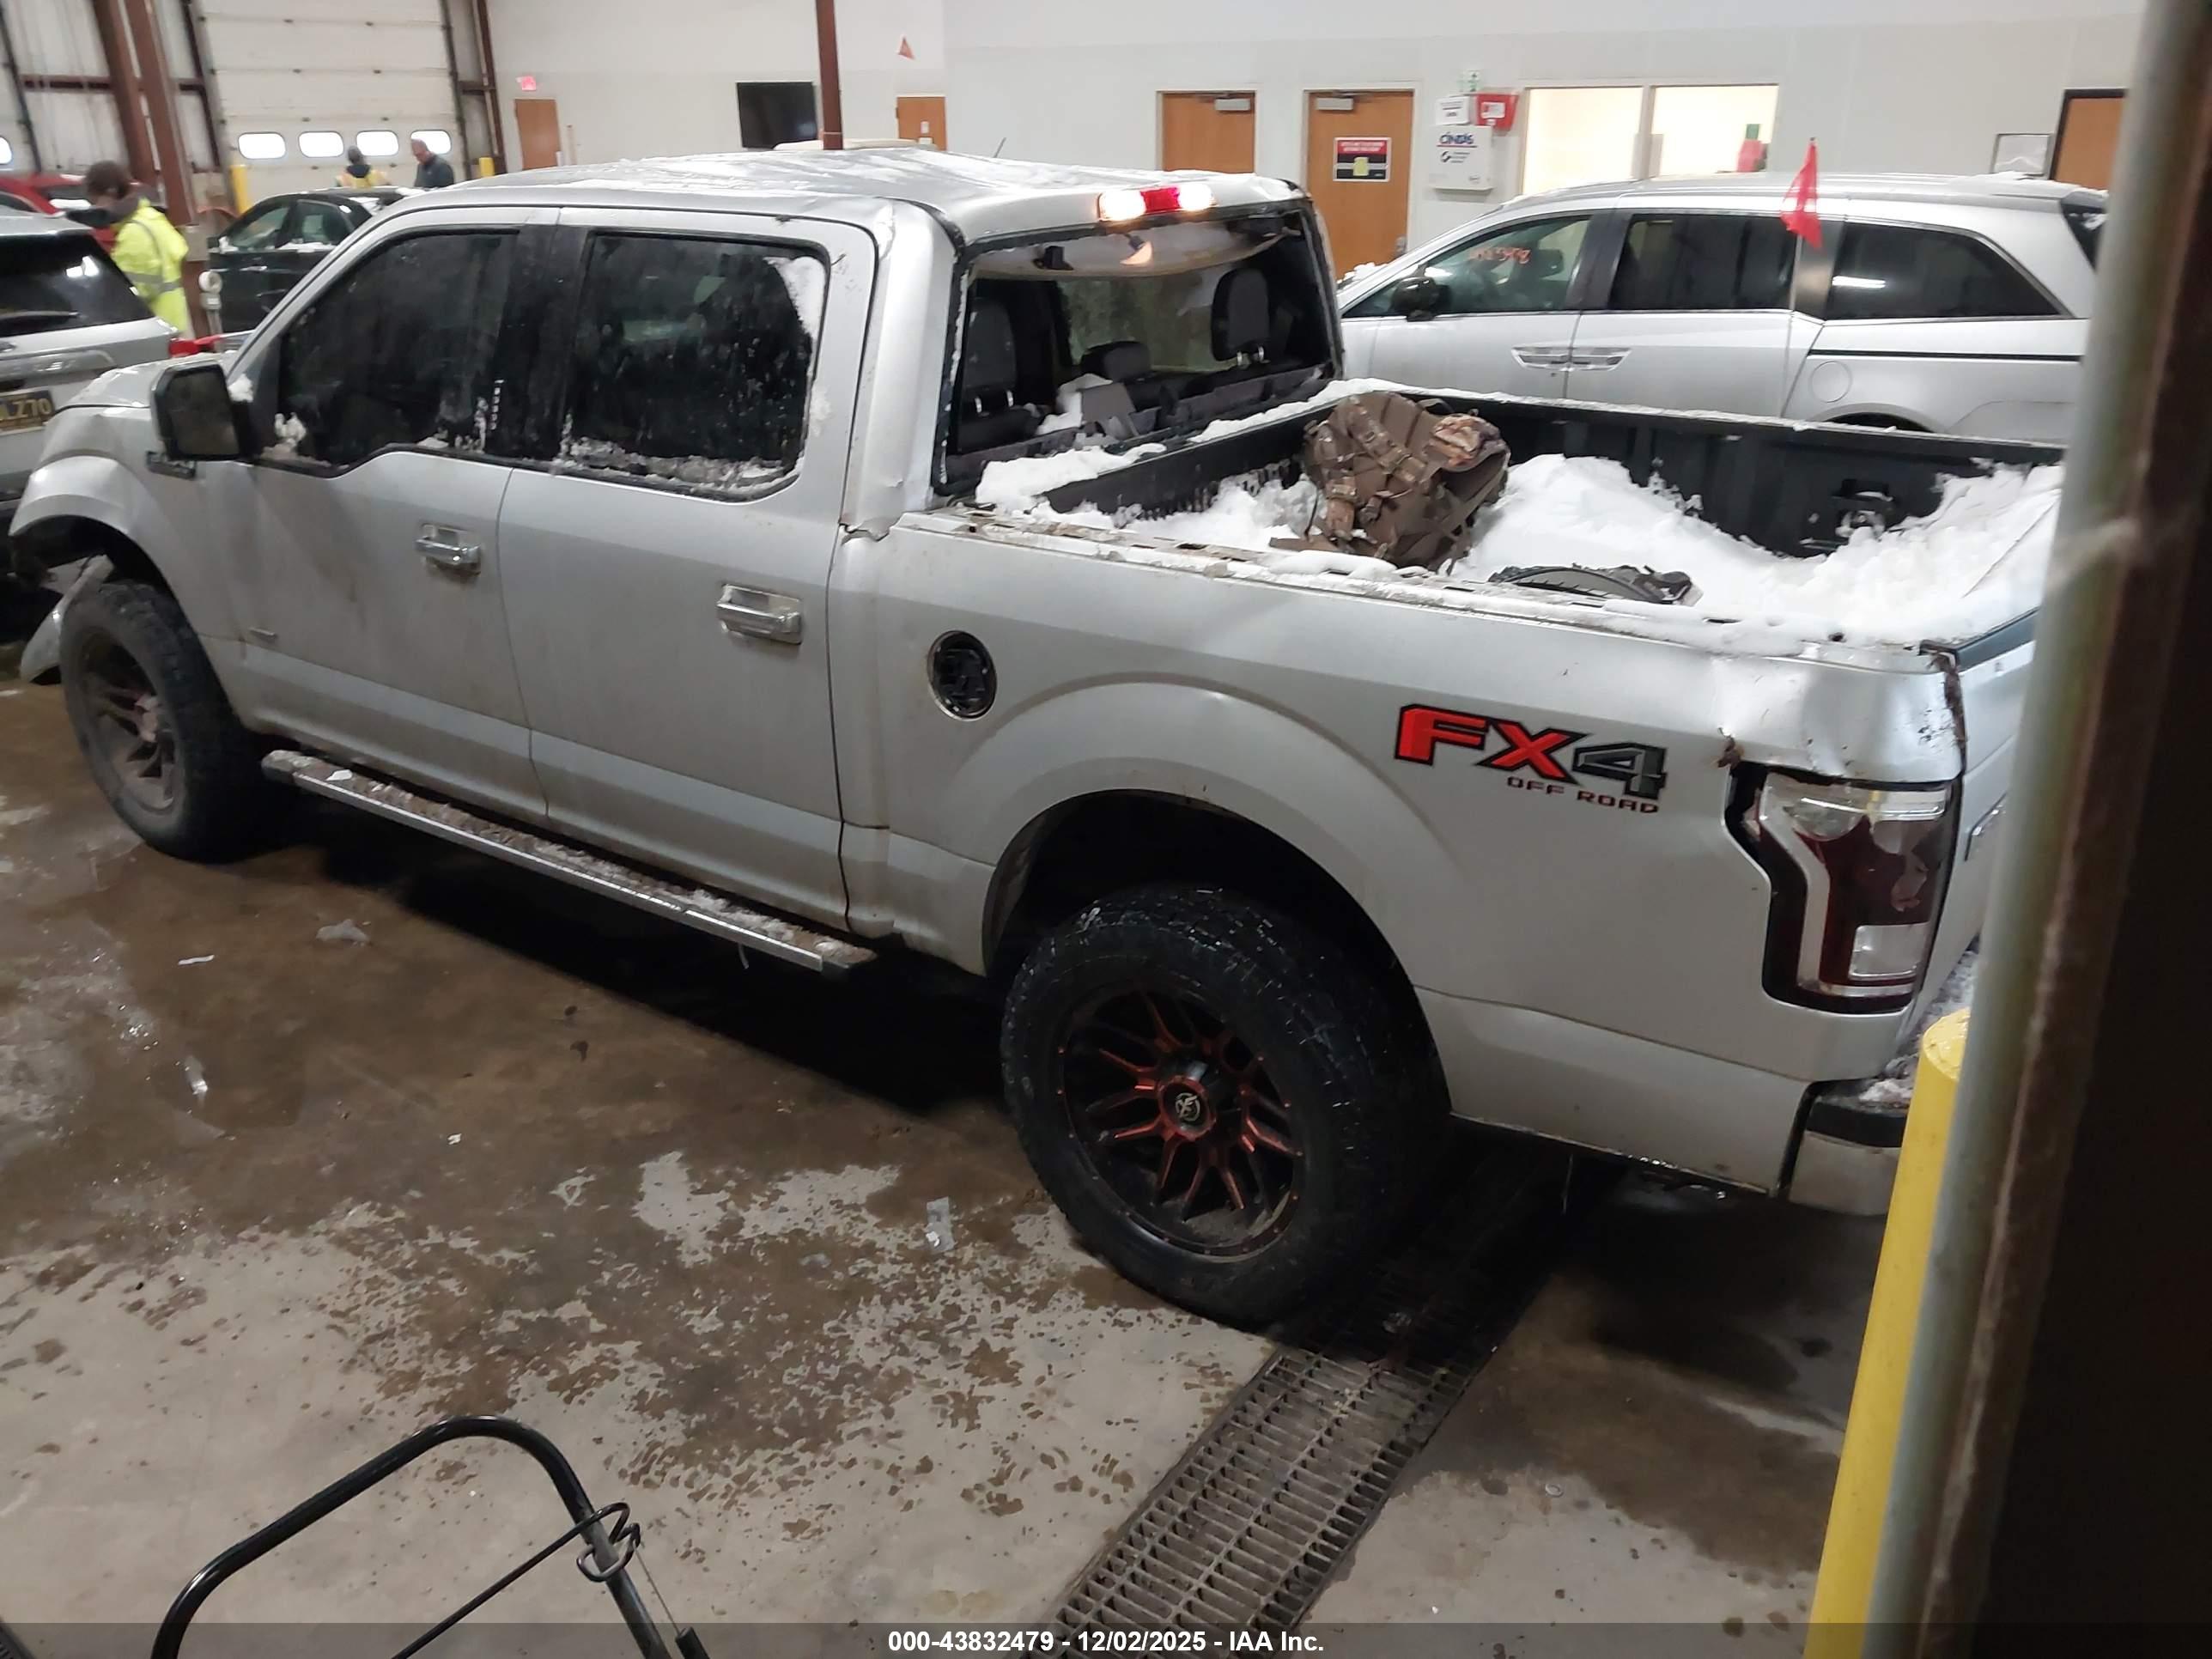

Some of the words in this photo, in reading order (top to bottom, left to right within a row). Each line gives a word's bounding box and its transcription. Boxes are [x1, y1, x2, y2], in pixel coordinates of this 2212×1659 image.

[1395, 703, 1668, 800] FX4
[1507, 775, 1565, 795] OFF
[1577, 789, 1660, 814] ROAD
